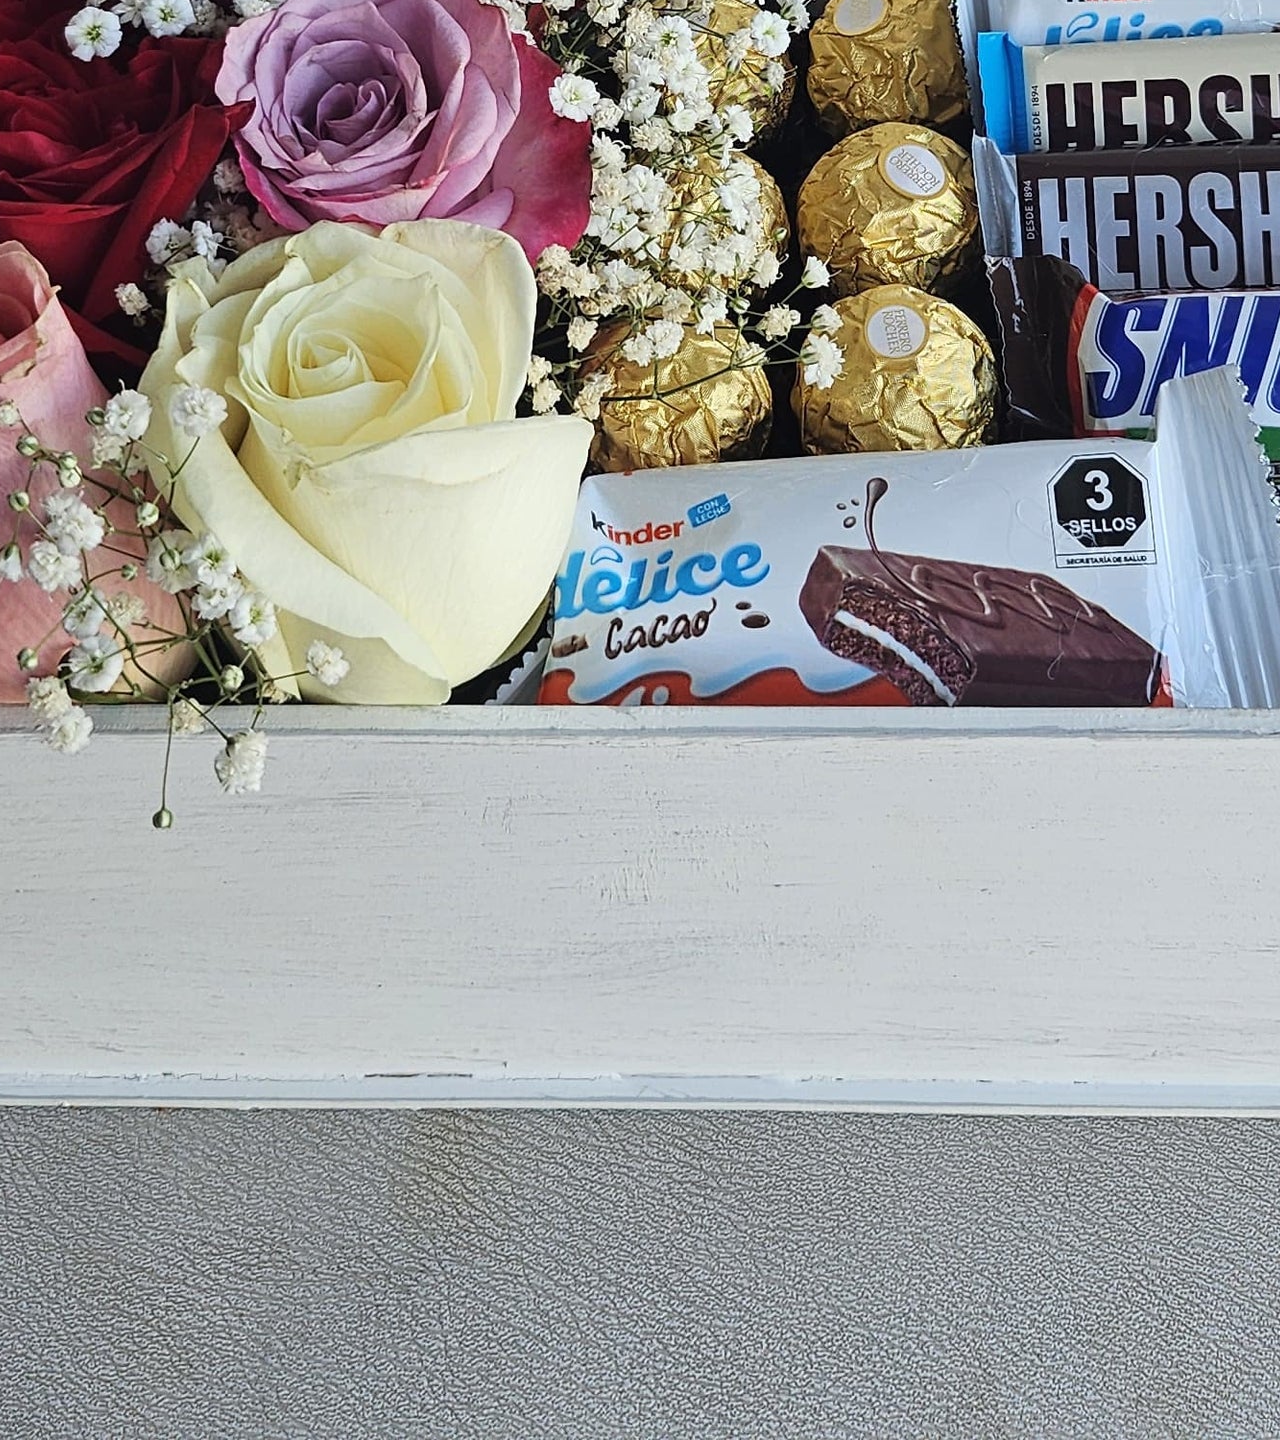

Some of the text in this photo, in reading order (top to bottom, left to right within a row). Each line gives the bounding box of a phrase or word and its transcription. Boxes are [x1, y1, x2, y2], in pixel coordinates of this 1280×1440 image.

[1031, 84, 1042, 146] DESDE 1894
[889, 156, 933, 193] FERRERO
[898, 149, 940, 187] ROCHER
[1023, 179, 1035, 241] DESDE 1894
[882, 310, 901, 355] ROCHER
[894, 309, 913, 352] FERRERO
[697, 499, 720, 514] CON
[1084, 469, 1114, 512] 3
[591, 510, 685, 546] kinder
[695, 505, 725, 524] LECHE
[1068, 516, 1138, 534] SELLOS
[604, 597, 717, 660] Cacao
